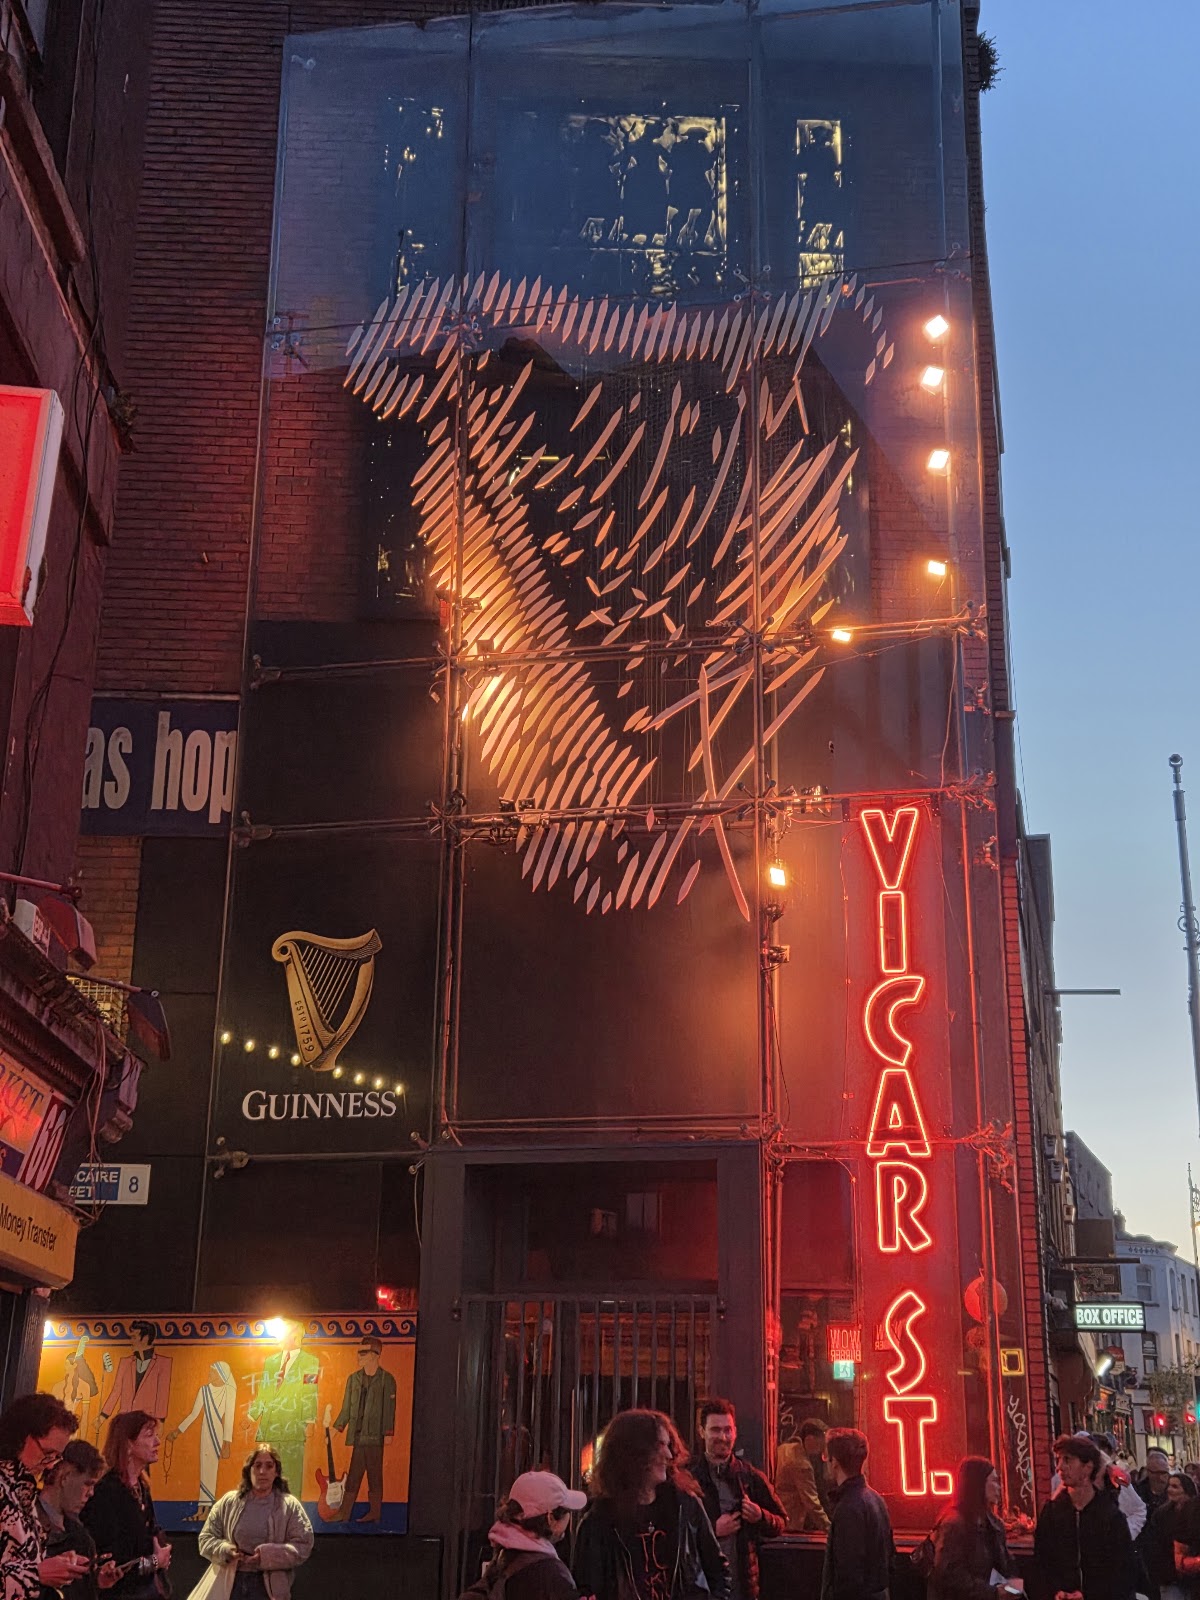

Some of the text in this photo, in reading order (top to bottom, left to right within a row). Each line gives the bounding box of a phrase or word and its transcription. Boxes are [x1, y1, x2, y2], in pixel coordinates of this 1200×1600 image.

[82, 710, 237, 824] as hop
[299, 1024, 315, 1052] 1759
[241, 1089, 397, 1121] GUINNESS
[861, 807, 953, 1495] VICAR ST.
[74, 1168, 119, 1183] CÁIRE
[128, 1176, 139, 1193] 8
[0, 1202, 57, 1251] Money Transfer
[1076, 1308, 1144, 1325] BOX OFFICE
